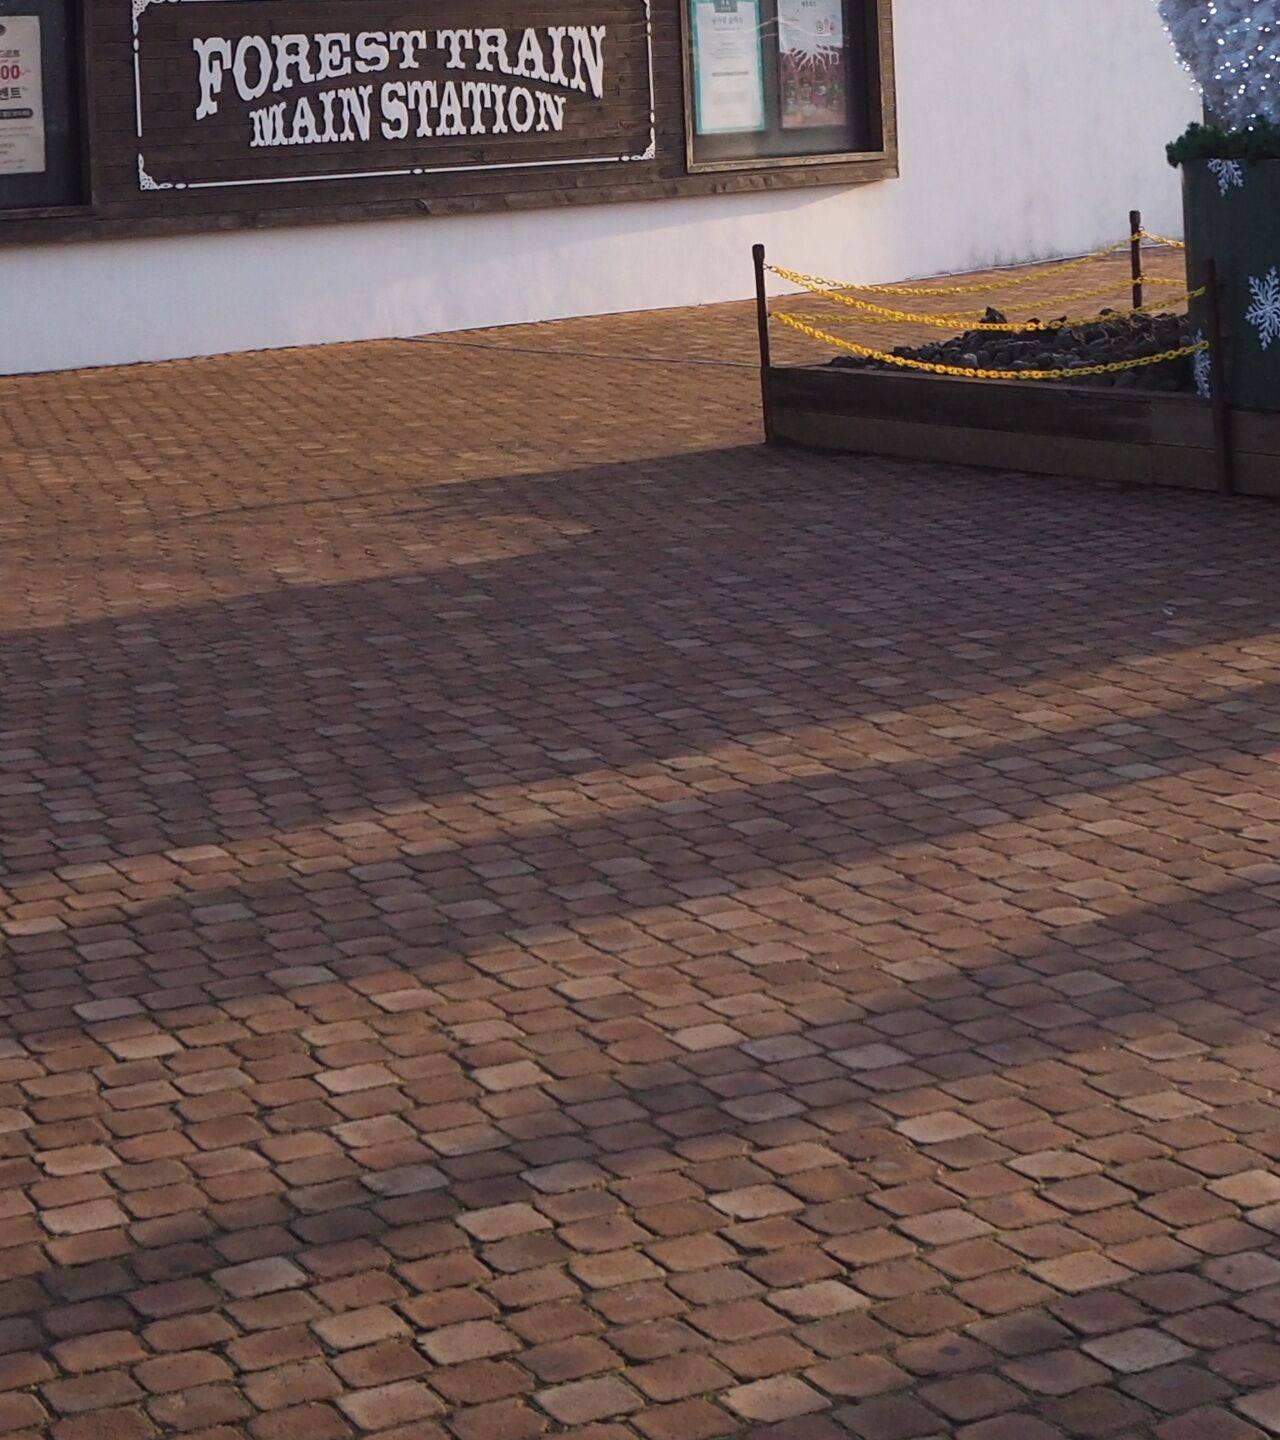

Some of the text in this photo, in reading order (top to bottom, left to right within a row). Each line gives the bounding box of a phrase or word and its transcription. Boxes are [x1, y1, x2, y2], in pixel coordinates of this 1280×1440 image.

[193, 25, 606, 121] FOREST TRAIN
[249, 80, 566, 148] MAIN STATION
